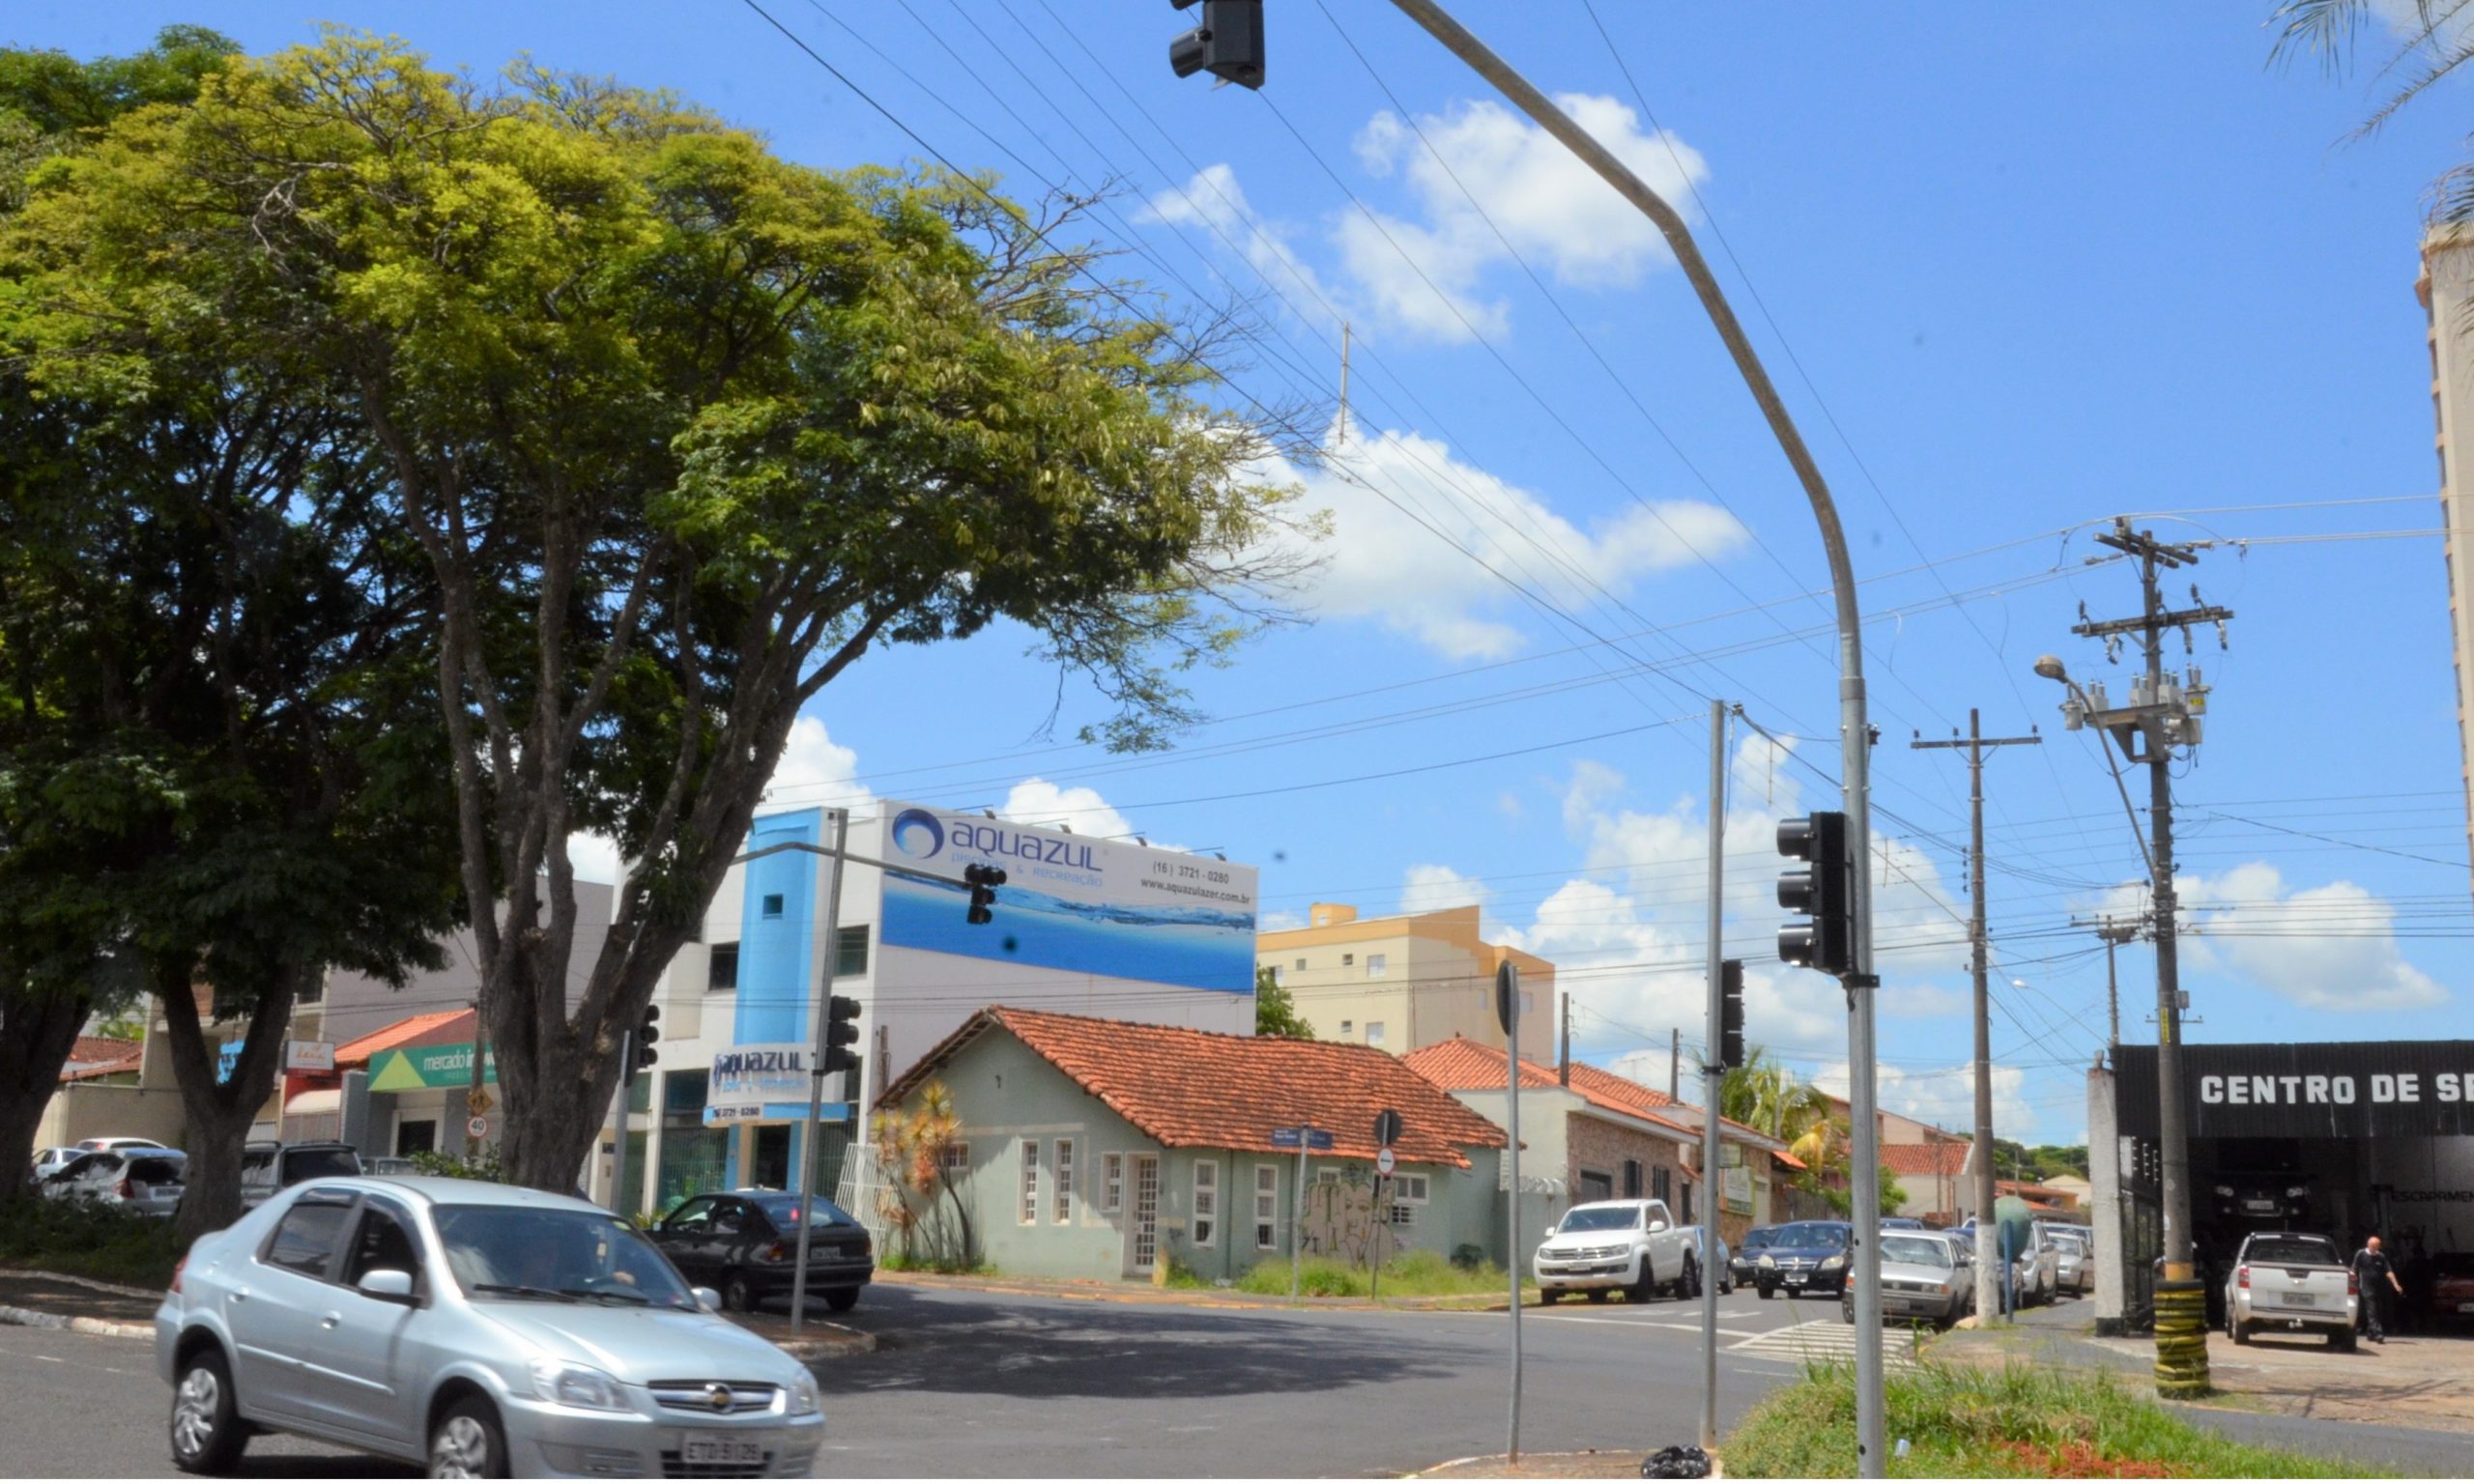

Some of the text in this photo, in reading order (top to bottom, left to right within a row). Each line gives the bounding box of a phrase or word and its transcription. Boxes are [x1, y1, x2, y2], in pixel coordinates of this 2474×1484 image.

[1178, 865, 1199, 879] 3721
[1207, 870, 1229, 884] 0280
[1140, 878, 1251, 904] www.aquazulazer.com.br
[423, 1049, 465, 1071] mercado
[2201, 1074, 2356, 1104] CENTRO
[2371, 1073, 2420, 1102] DE
[471, 1121, 483, 1130] 40
